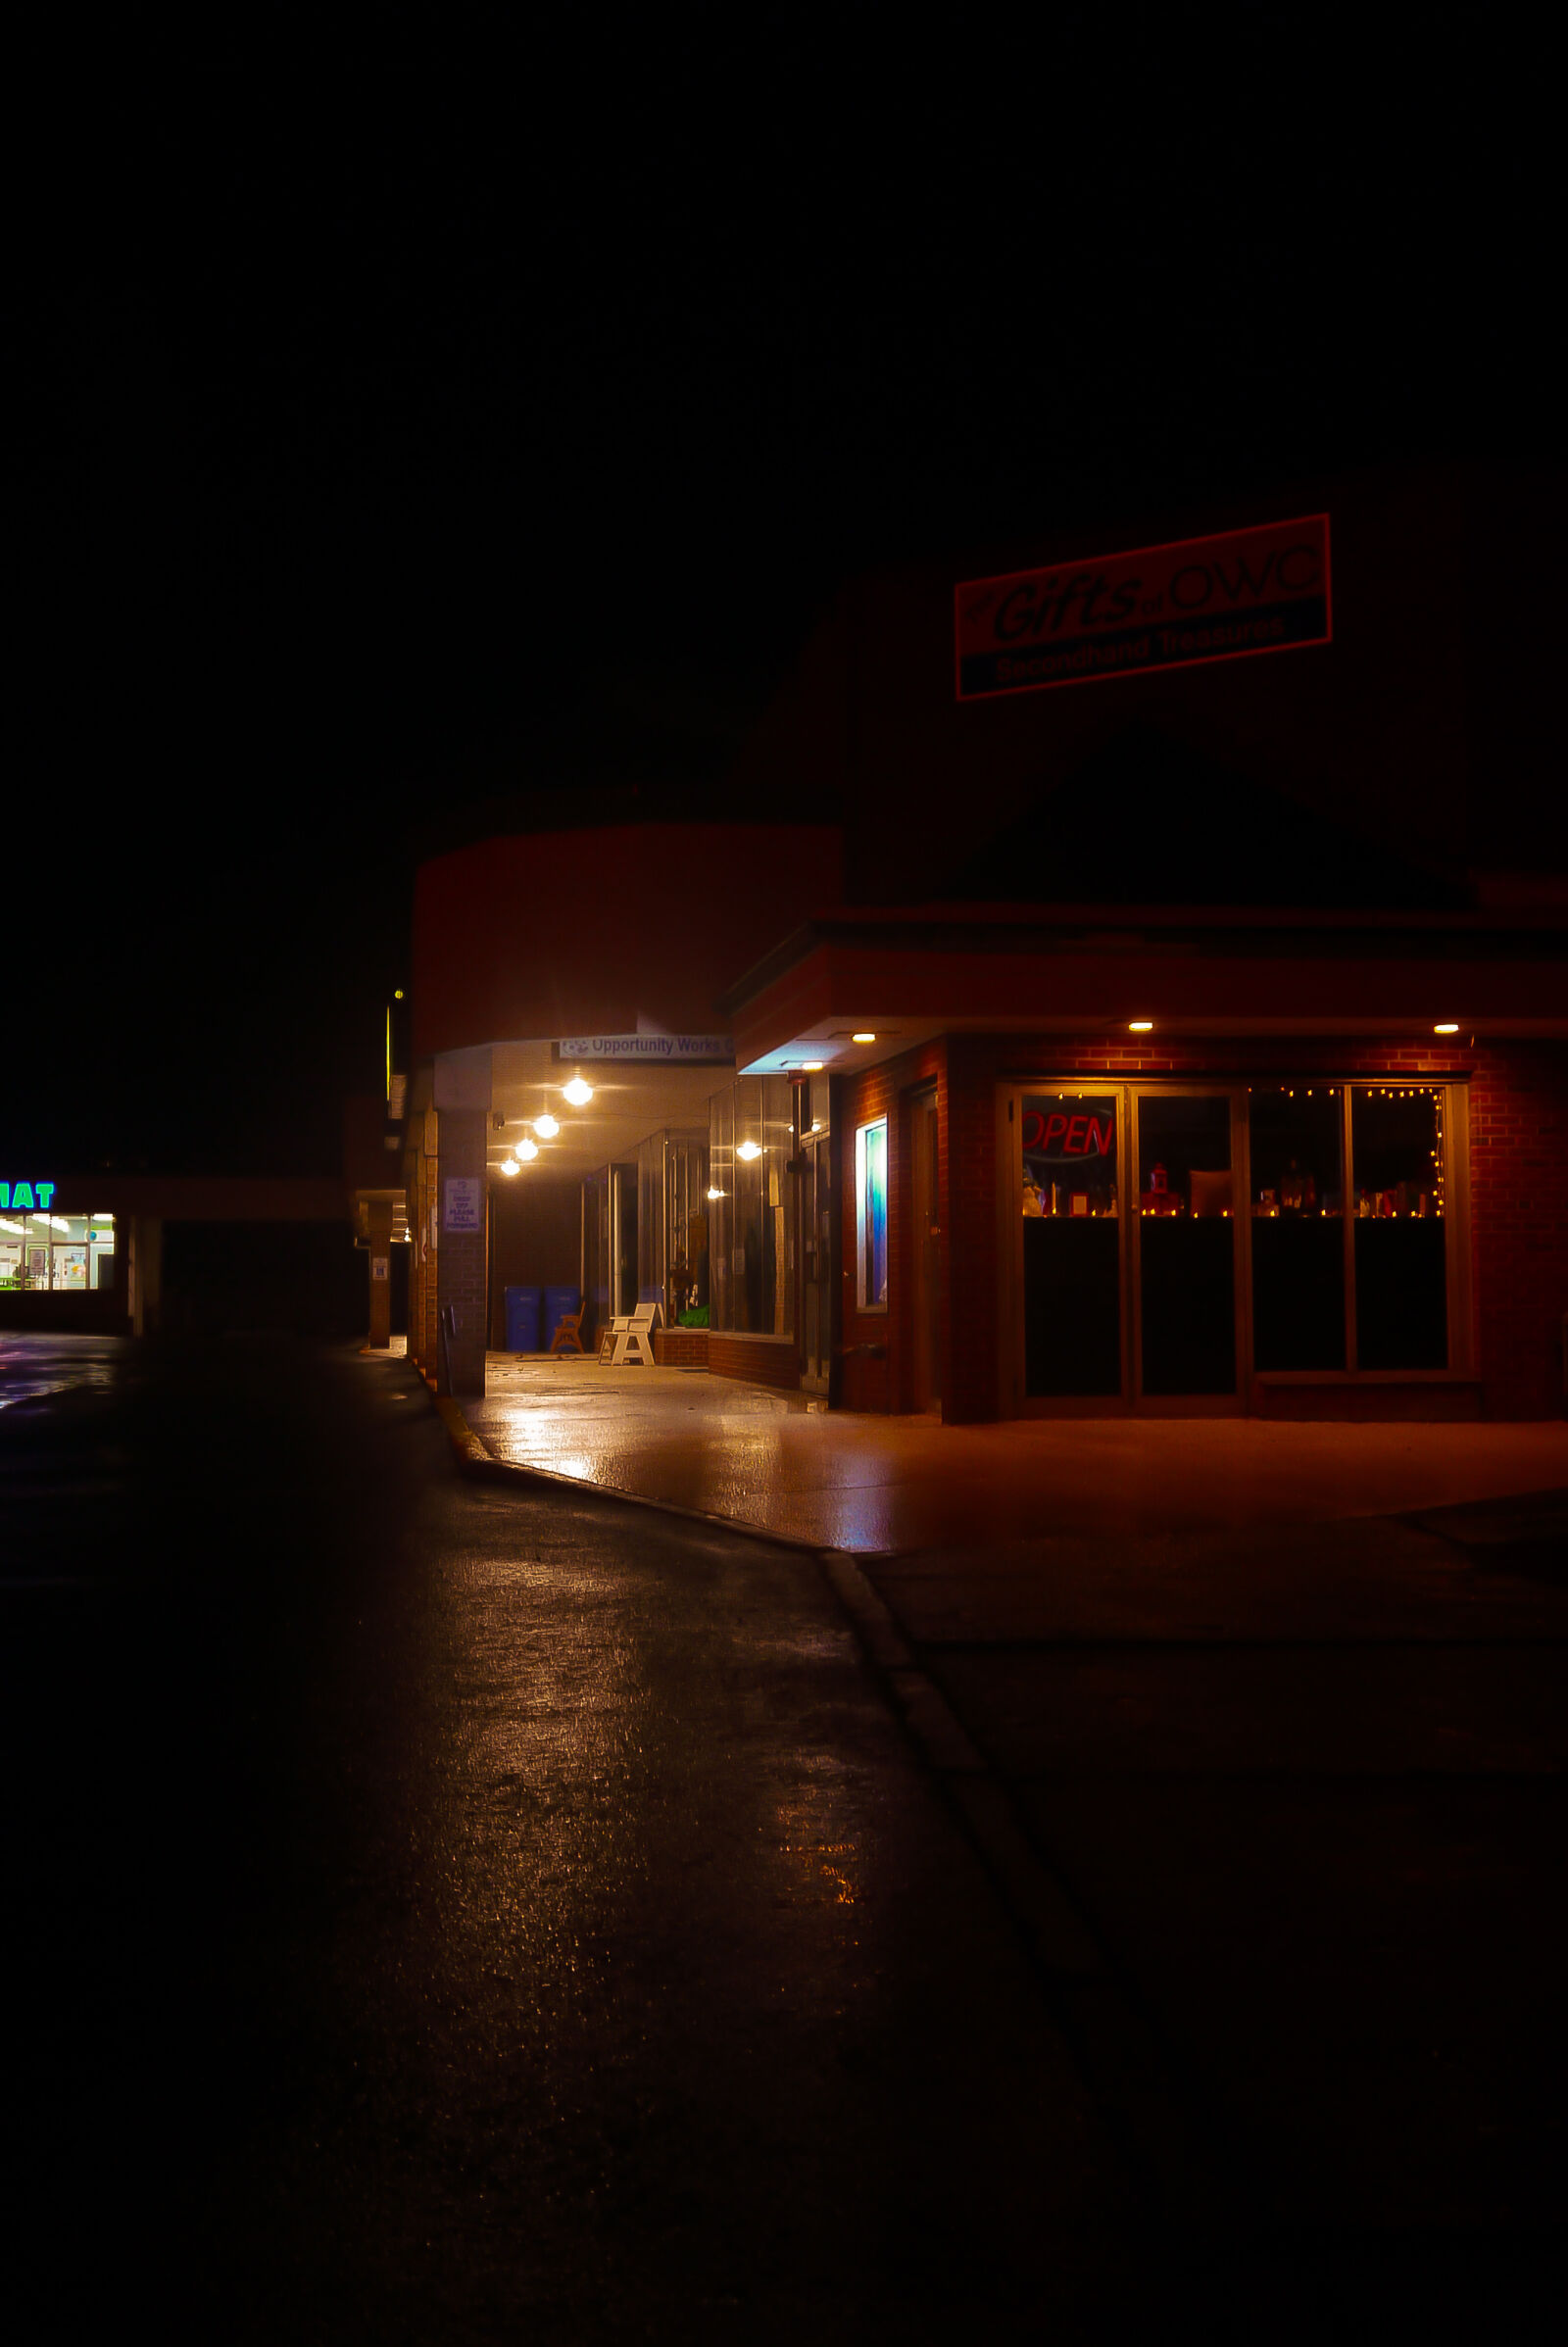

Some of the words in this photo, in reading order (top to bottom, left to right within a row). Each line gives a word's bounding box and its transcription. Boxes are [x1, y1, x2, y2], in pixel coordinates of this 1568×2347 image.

[994, 572, 1143, 641] Gifts
[1168, 542, 1320, 611] OWC
[996, 635, 1149, 683] Secondhand
[1158, 614, 1285, 656] Treasures
[592, 1037, 673, 1055] Opportunity
[679, 1037, 720, 1052] Works
[1022, 1110, 1114, 1156] OPEN
